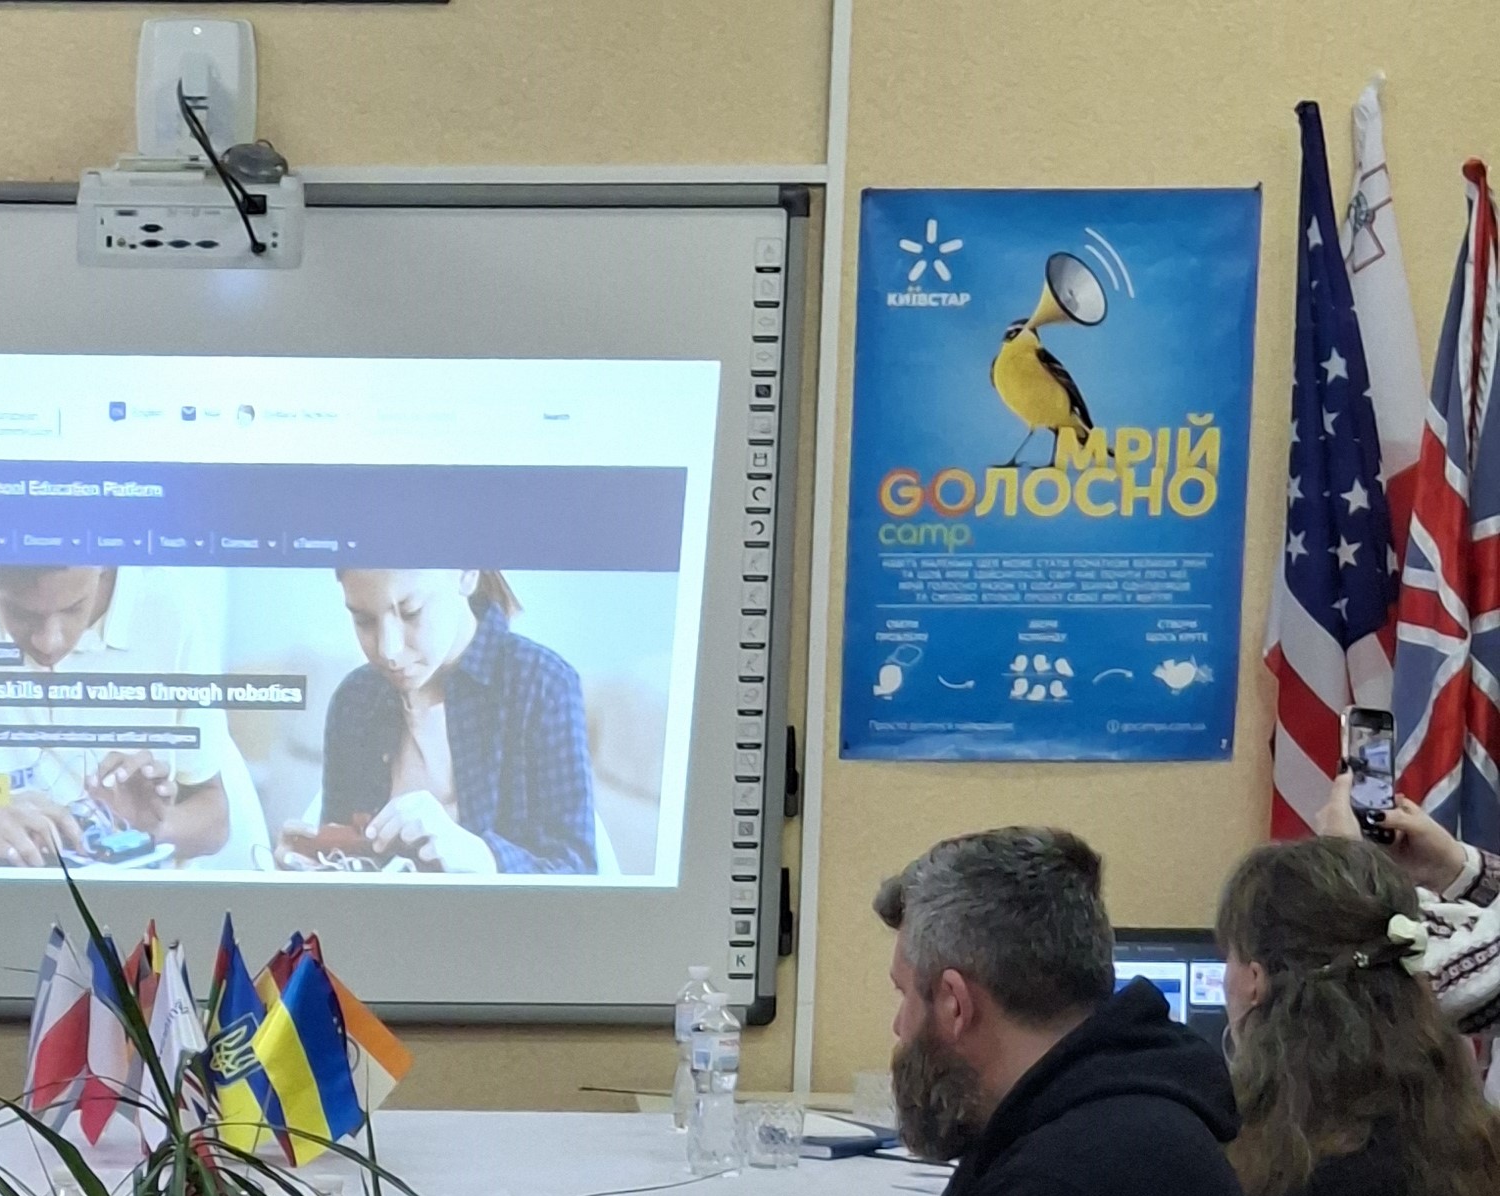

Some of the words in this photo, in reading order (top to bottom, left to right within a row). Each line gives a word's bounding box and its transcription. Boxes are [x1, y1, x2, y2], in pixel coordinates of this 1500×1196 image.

[1055, 413, 1221, 471] МРІЙ
[29, 480, 100, 497] Education
[103, 481, 164, 498] Platform
[47, 681, 83, 700] and
[86, 684, 146, 701] values
[150, 682, 223, 706] through
[227, 683, 303, 704] robotics
